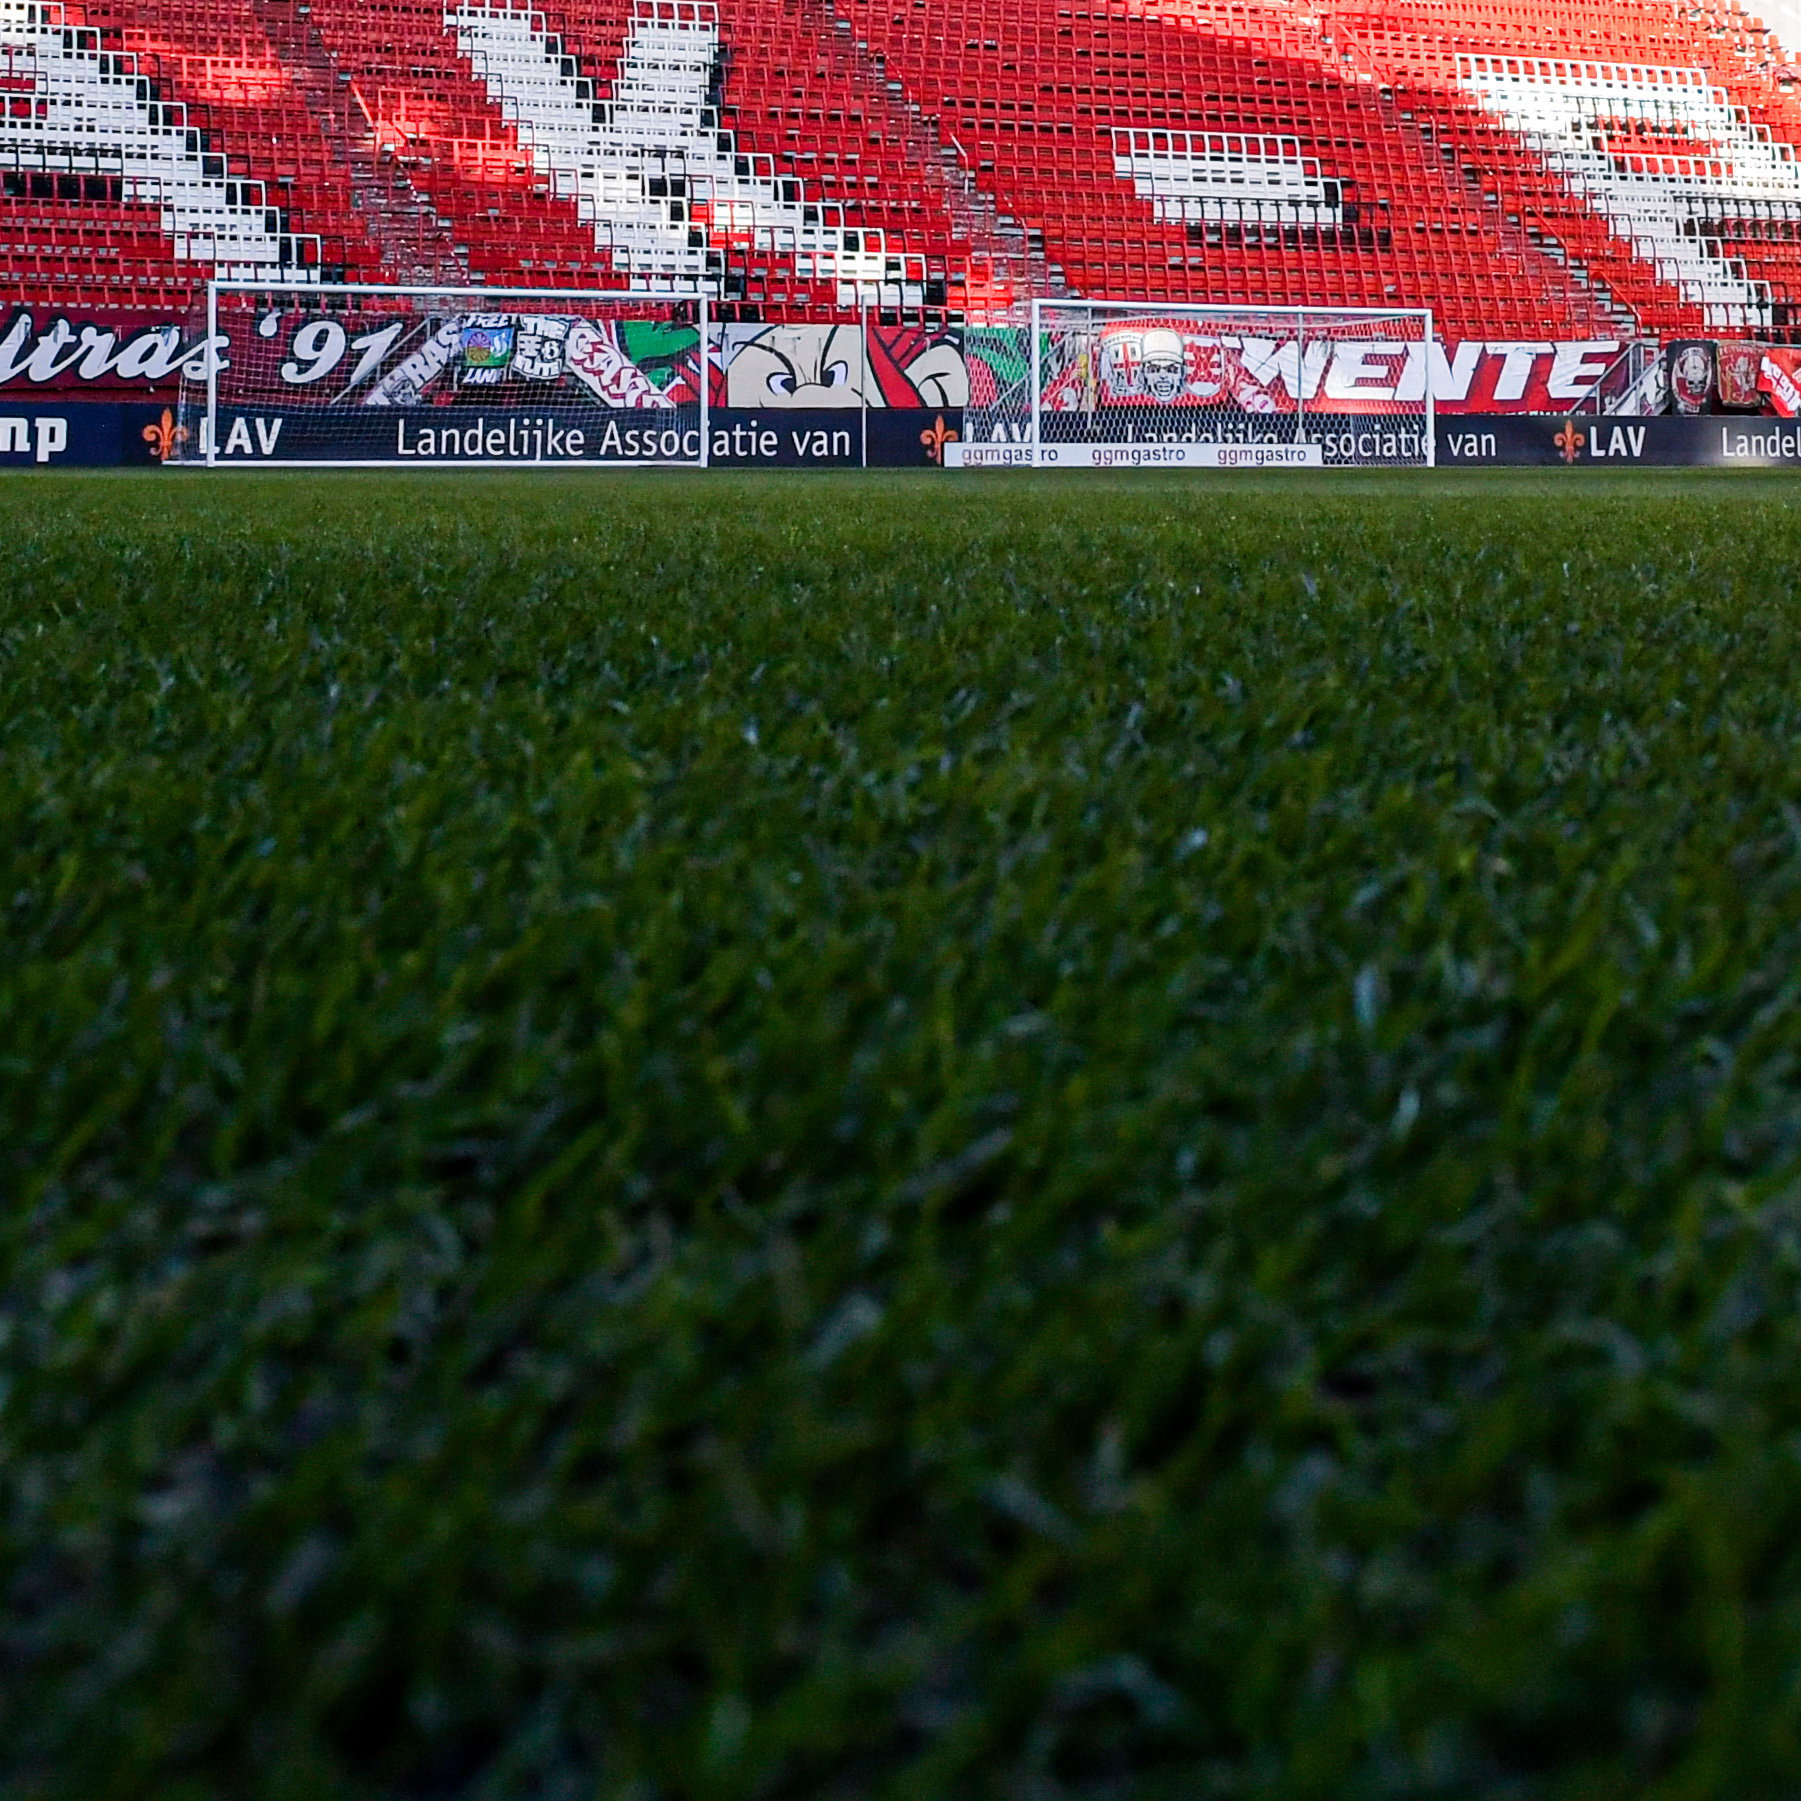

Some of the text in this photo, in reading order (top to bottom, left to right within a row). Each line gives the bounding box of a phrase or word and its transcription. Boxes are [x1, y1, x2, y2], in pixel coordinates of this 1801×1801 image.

[398, 418, 585, 462] Landelijke
[601, 418, 778, 457] Associatie
[791, 429, 850, 457] van
[1447, 433, 1497, 457] van
[1590, 426, 1646, 457] LAV
[1092, 446, 1186, 465] ggmgastro
[1217, 446, 1307, 465] ggmgastro
